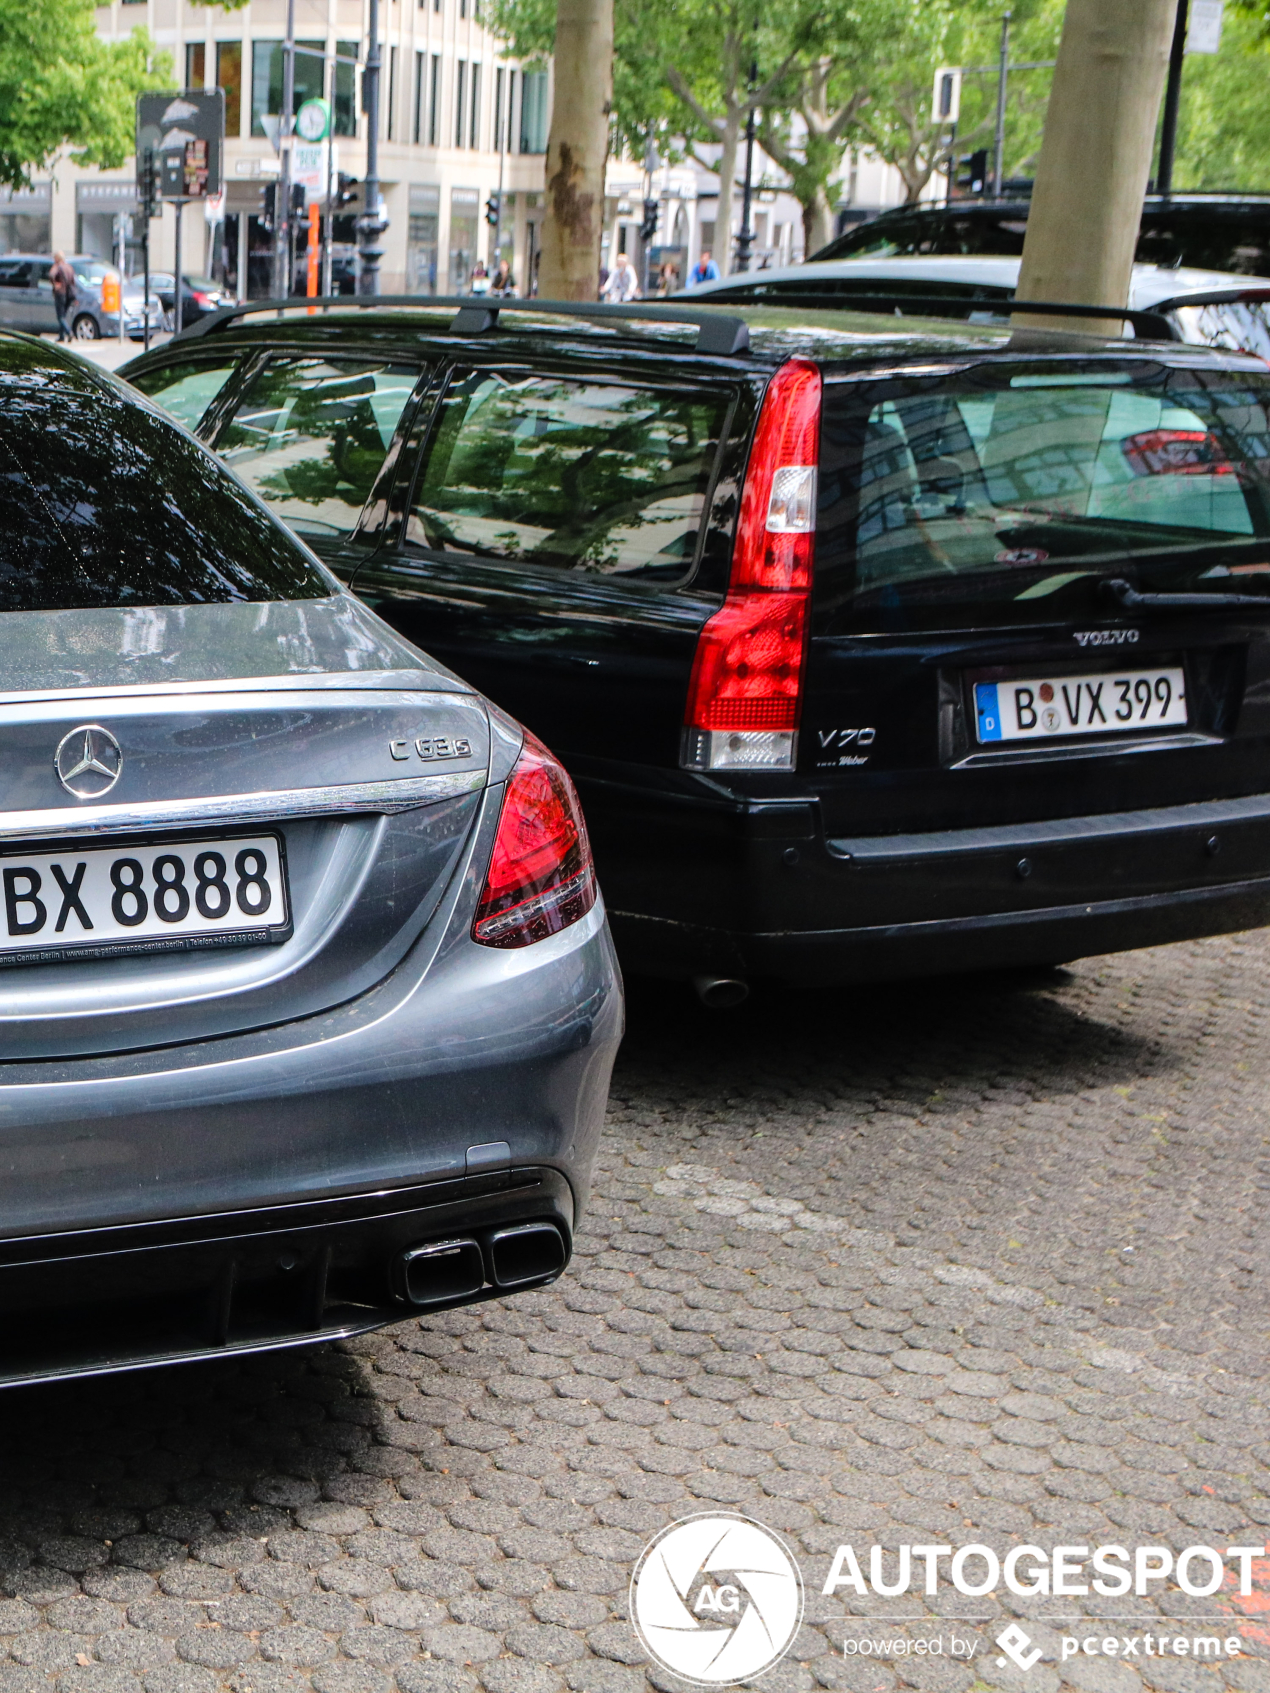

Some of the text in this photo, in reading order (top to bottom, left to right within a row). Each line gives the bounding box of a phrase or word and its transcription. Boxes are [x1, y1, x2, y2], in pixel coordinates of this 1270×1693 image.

[1073, 629, 1140, 647] VOLVO
[986, 677, 1172, 731] D B VX 399
[389, 740, 410, 761] C
[3, 862, 94, 936] BX
[109, 848, 271, 927] 8888
[190, 934, 213, 945] Telefon
[17, 953, 40, 962] Center
[40, 951, 60, 960] Berlin
